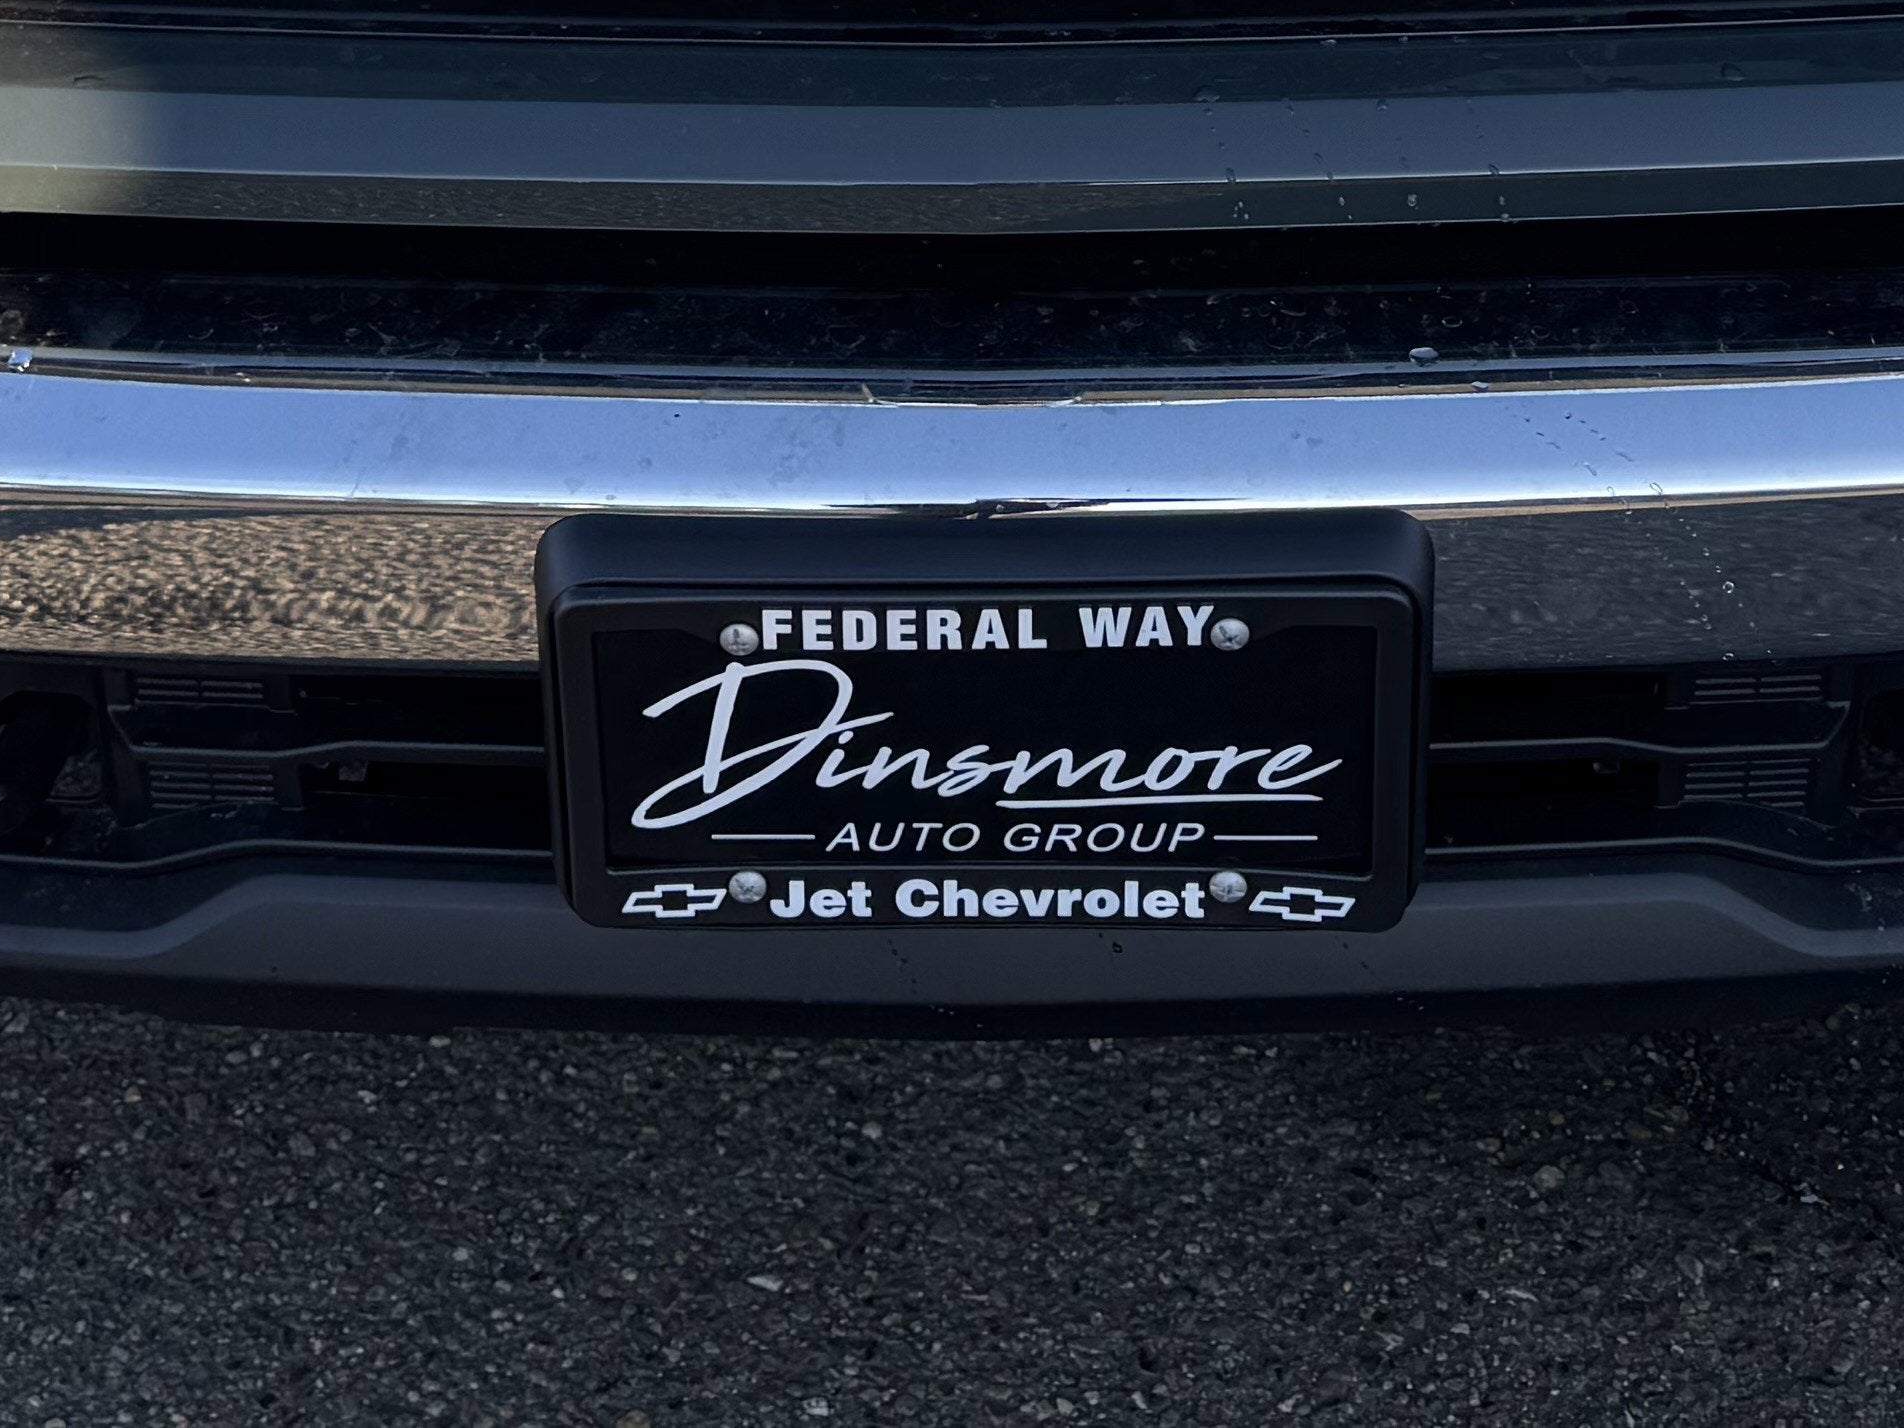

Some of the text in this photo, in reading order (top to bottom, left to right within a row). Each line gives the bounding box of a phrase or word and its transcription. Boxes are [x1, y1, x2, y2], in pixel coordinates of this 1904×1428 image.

[761, 605, 1215, 651] FEDERAL WAY
[630, 659, 1344, 830] Dinsmore
[825, 822, 1206, 853] AUTO GROUP
[769, 878, 1206, 919] Jet Chevrolet
